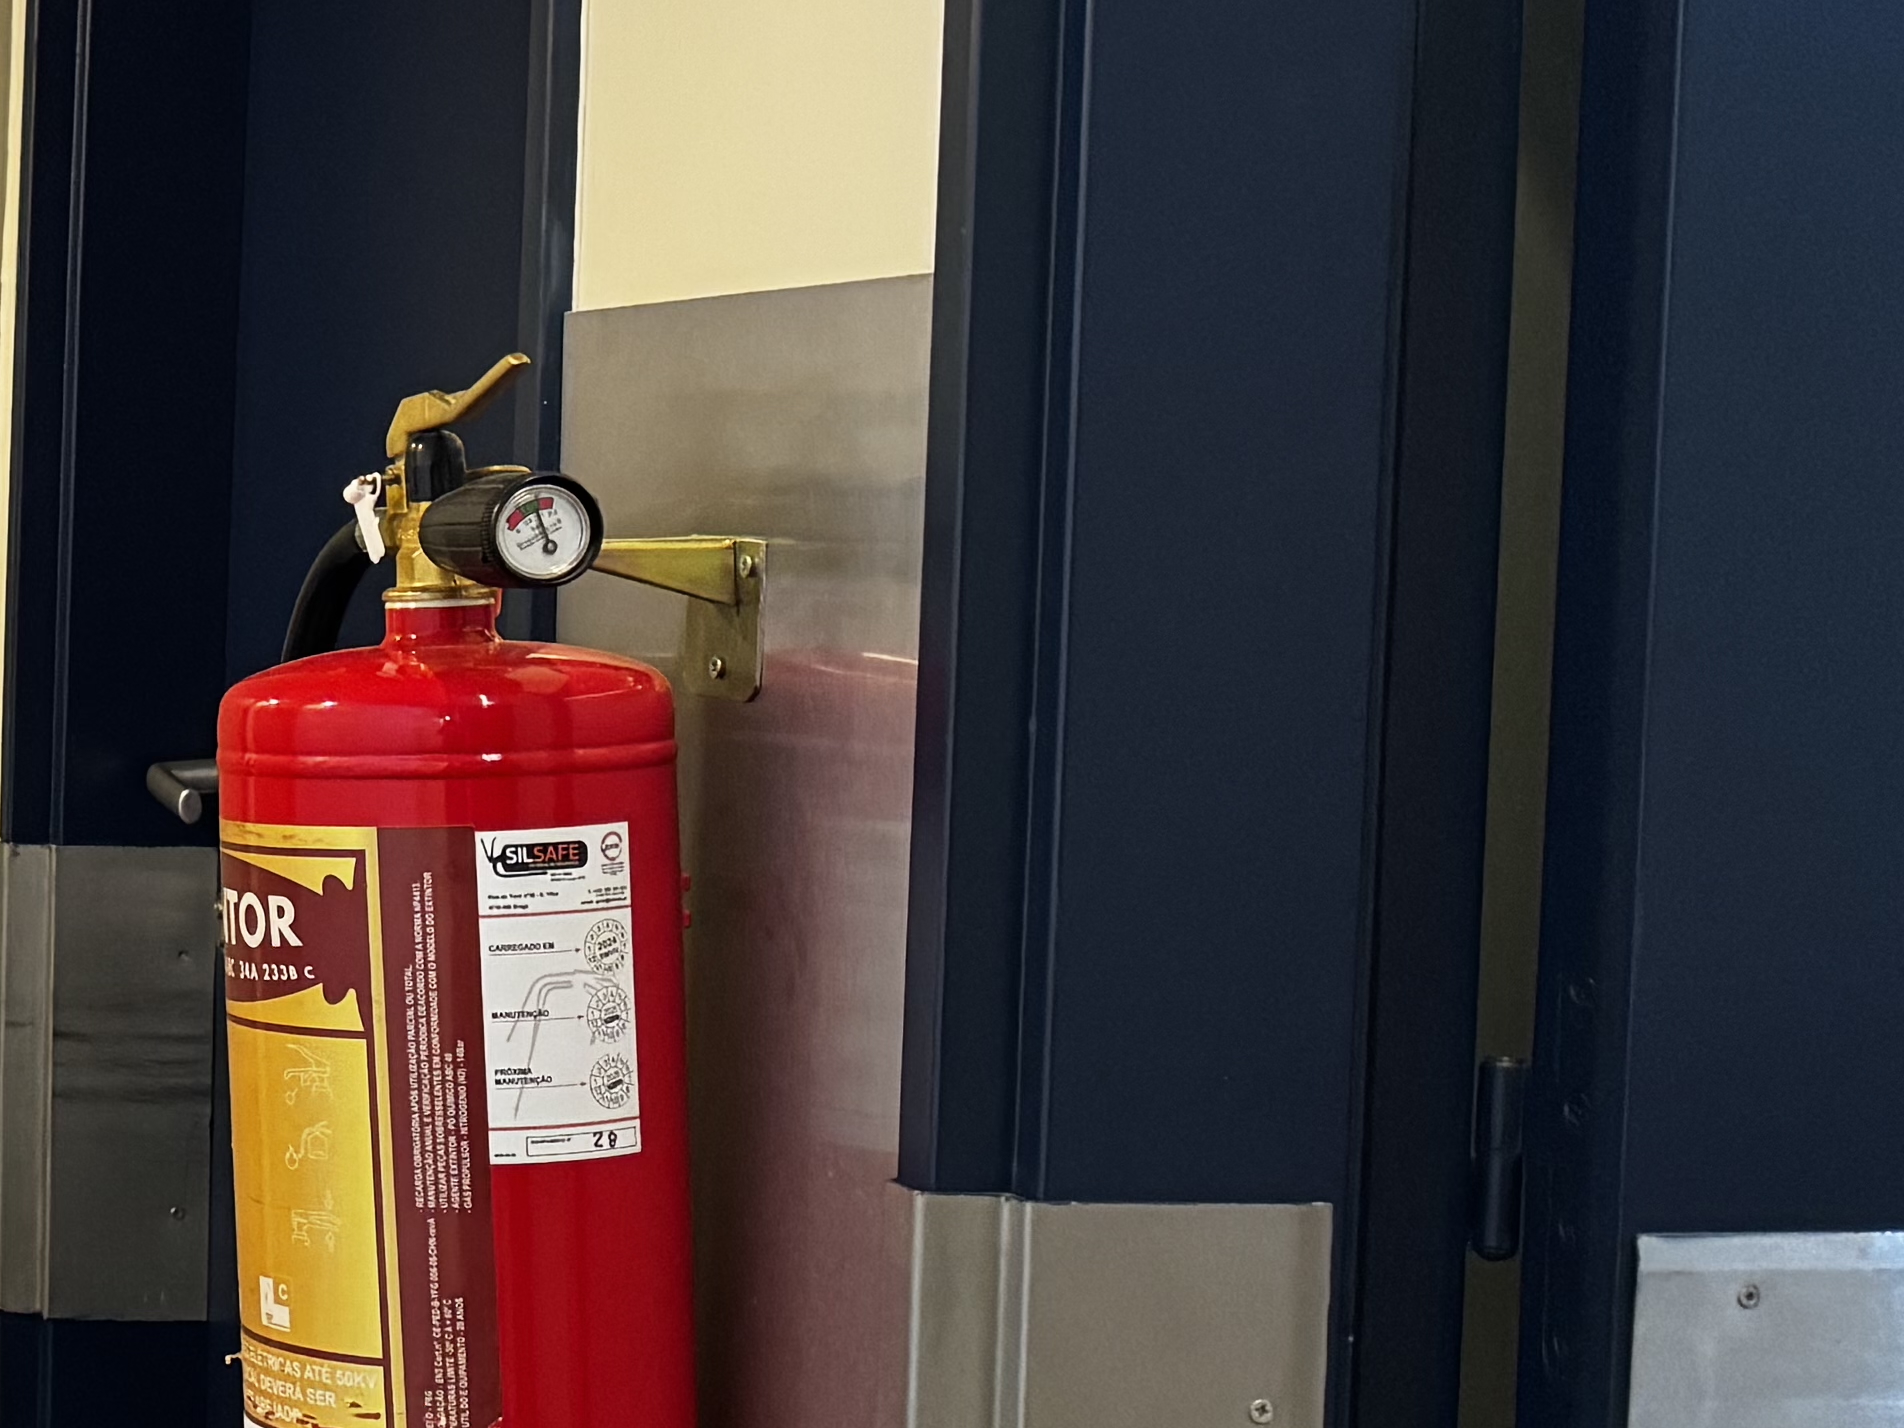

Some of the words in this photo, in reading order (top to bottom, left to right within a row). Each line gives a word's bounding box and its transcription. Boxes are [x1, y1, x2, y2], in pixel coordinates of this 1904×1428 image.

[505, 843, 580, 865] SILSAFE
[424, 872, 433, 912] EXTINTOR
[426, 913, 434, 925] DO
[427, 926, 436, 961] MODELO
[488, 942, 541, 952] CARREGADO
[262, 963, 298, 981] 233B
[304, 965, 316, 979] C
[416, 951, 424, 970] COM
[429, 971, 437, 989] COM
[406, 992, 414, 1005] OU
[491, 1009, 549, 1020] MANUTENÇÃO
[407, 1042, 419, 1088] UTILIZAÇÃO
[494, 1067, 533, 1076] PRÓXIMA
[420, 1062, 432, 1115] VERIFICAÇÃO
[494, 1075, 553, 1086] MANUTENÇÃO
[409, 1090, 419, 1112] APÓS
[410, 1114, 422, 1168] OBRIGATÓRIA
[424, 1124, 433, 1151] ANUAL
[436, 1144, 447, 1171] PEÇAS
[449, 1135, 458, 1175] EXTINTOR
[462, 1140, 471, 1190] PROPULSOR
[414, 1169, 424, 1208] RECARGA
[424, 1152, 437, 1208] MANUTENÇÃO
[439, 1173, 448, 1208] UTILIZAR
[451, 1176, 460, 1209] AGENTE
[278, 1283, 288, 1301] C
[455, 1297, 464, 1320] ANOS
[304, 1363, 332, 1384] ATÉ
[446, 1357, 455, 1383] LIMITE
[260, 1373, 304, 1402] DEVERÁ
[306, 1387, 336, 1408] SER
[460, 1397, 468, 1409] DO
